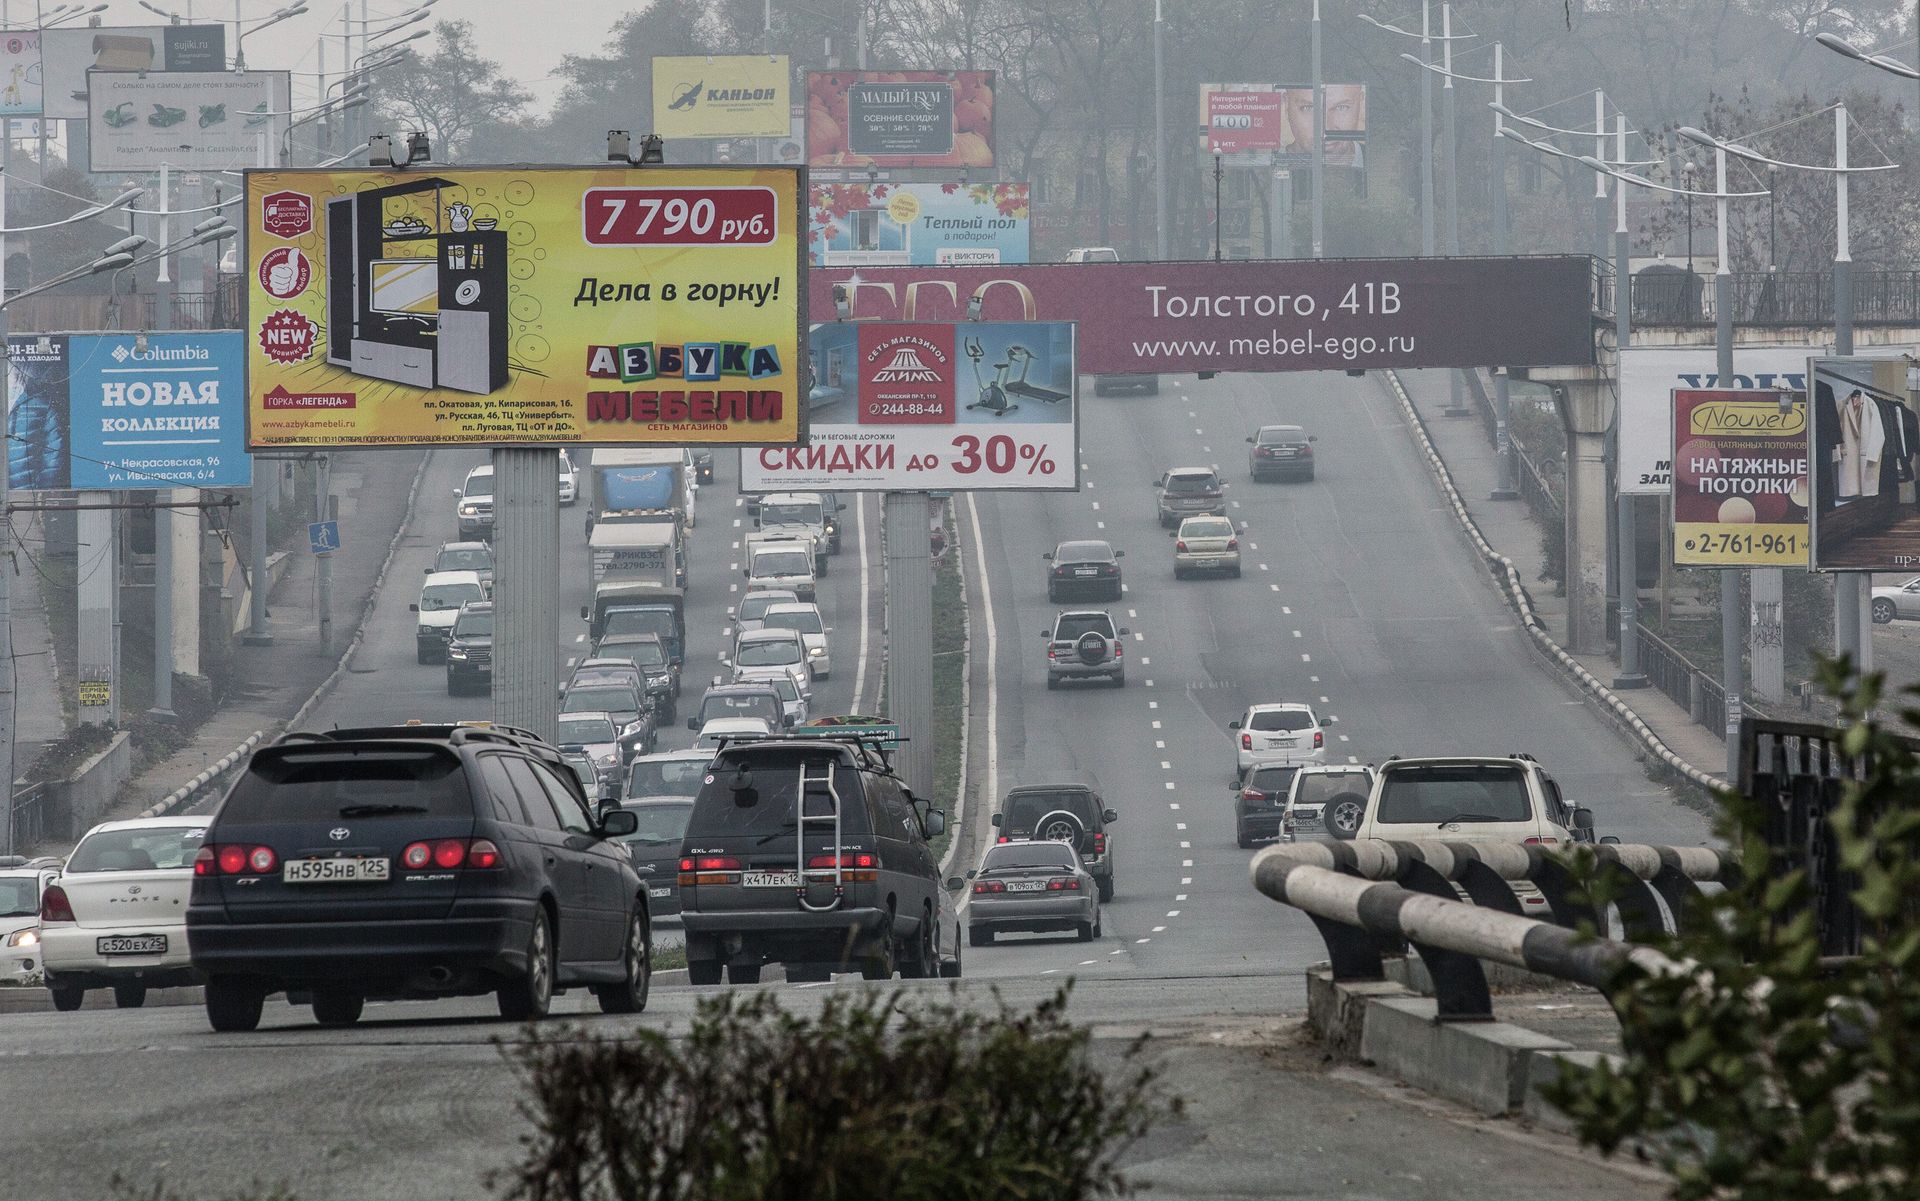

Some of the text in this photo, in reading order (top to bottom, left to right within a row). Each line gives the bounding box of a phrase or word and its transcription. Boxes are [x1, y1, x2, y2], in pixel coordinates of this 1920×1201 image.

[174, 40, 208, 51] sujiki.ru
[112, 81, 145, 89] Сколько
[224, 81, 264, 89] запчасти?
[707, 88, 776, 101] КАНЬОН
[861, 88, 910, 103] МАЛЫЙ
[1211, 95, 1246, 103] Интернет
[863, 114, 939, 122] ОСЕННИЕ СКИДКИ
[1215, 116, 1249, 129] 100
[116, 146, 144, 154] Раздел
[600, 198, 770, 241] 7 790 руб.
[923, 216, 1016, 229] Теплый пол
[952, 232, 996, 242] подарок!
[954, 252, 995, 260] ВИКТОРИ
[574, 276, 780, 307] Дела в горку!
[1145, 282, 1401, 321] Толстого, 41В
[267, 329, 307, 345] NEW
[130, 345, 209, 361] Columbia
[868, 336, 946, 363] СЕТЬ МАГАЗИНОВ
[588, 342, 782, 379] АЗБУКА
[871, 371, 943, 382] ОЛИМП
[101, 381, 220, 406] НОВАЯ
[268, 396, 348, 407] ГОРКА «ЛЕГЕНДА»
[438, 400, 483, 409] Окатовая,
[484, 400, 497, 410] ул.
[498, 400, 558, 409] Кипарисовая,
[587, 390, 783, 422] МЕБЕЛИ
[882, 403, 943, 415] 244-88-44
[435, 411, 575, 421] ул. Русская, 46, ТЦ «Универбыт».
[102, 416, 220, 433] КОЛЛЕКЦИЯ
[262, 419, 356, 430] www.azbykamebeli.ru
[476, 424, 514, 433] Луговая,
[516, 423, 528, 432] ТЦ
[529, 423, 546, 431] «ОТ
[554, 423, 575, 431] ДО».
[647, 423, 728, 431] СЕТЬ МАГАЗИНОВ
[1690, 441, 1807, 449] ЗАВОД НАТЯЖНЫХ ПОТОЛКОВ
[760, 444, 895, 473] СКИДКИ
[951, 434, 1056, 475] 30%
[121, 457, 205, 469] Некрасовская,
[207, 457, 220, 466] 96
[1690, 457, 1807, 475] НАТЯЖНЫЕ
[108, 470, 215, 483] ул. Ивановская, 6/4
[1699, 477, 1798, 494] ПОТОЛКИ
[1699, 533, 1796, 554] 2-761-961
